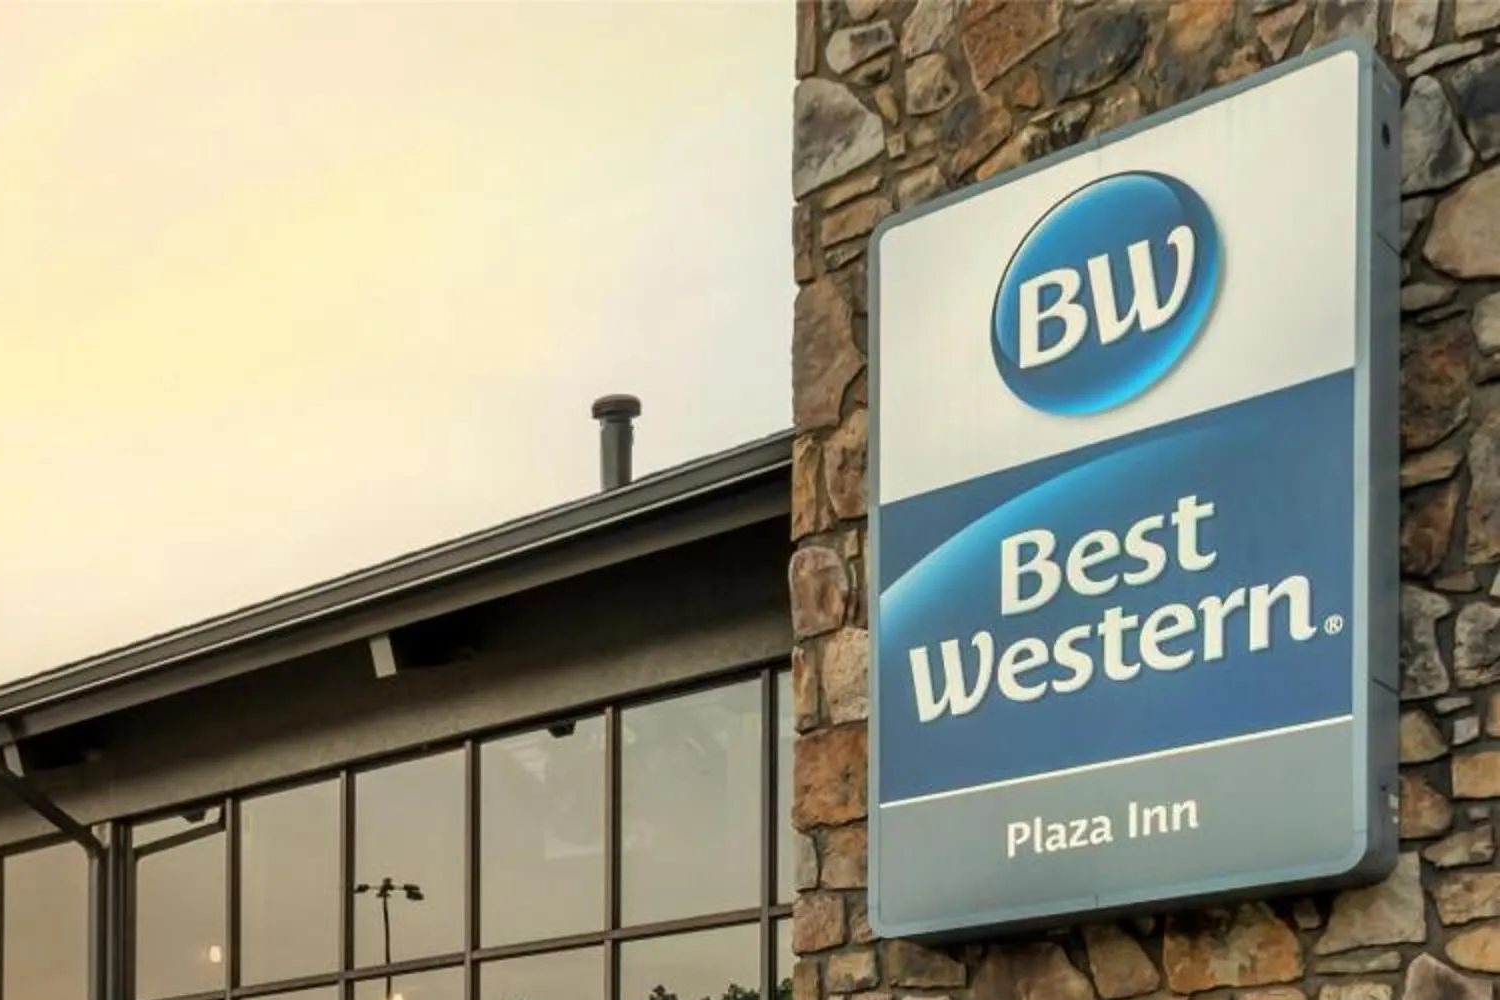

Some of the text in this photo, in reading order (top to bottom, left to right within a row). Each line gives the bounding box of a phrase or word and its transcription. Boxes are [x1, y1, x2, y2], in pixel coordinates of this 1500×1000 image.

[1018, 225, 1196, 370] BW
[1000, 495, 1218, 615] Best
[1007, 800, 1199, 857] Plaza Inn
